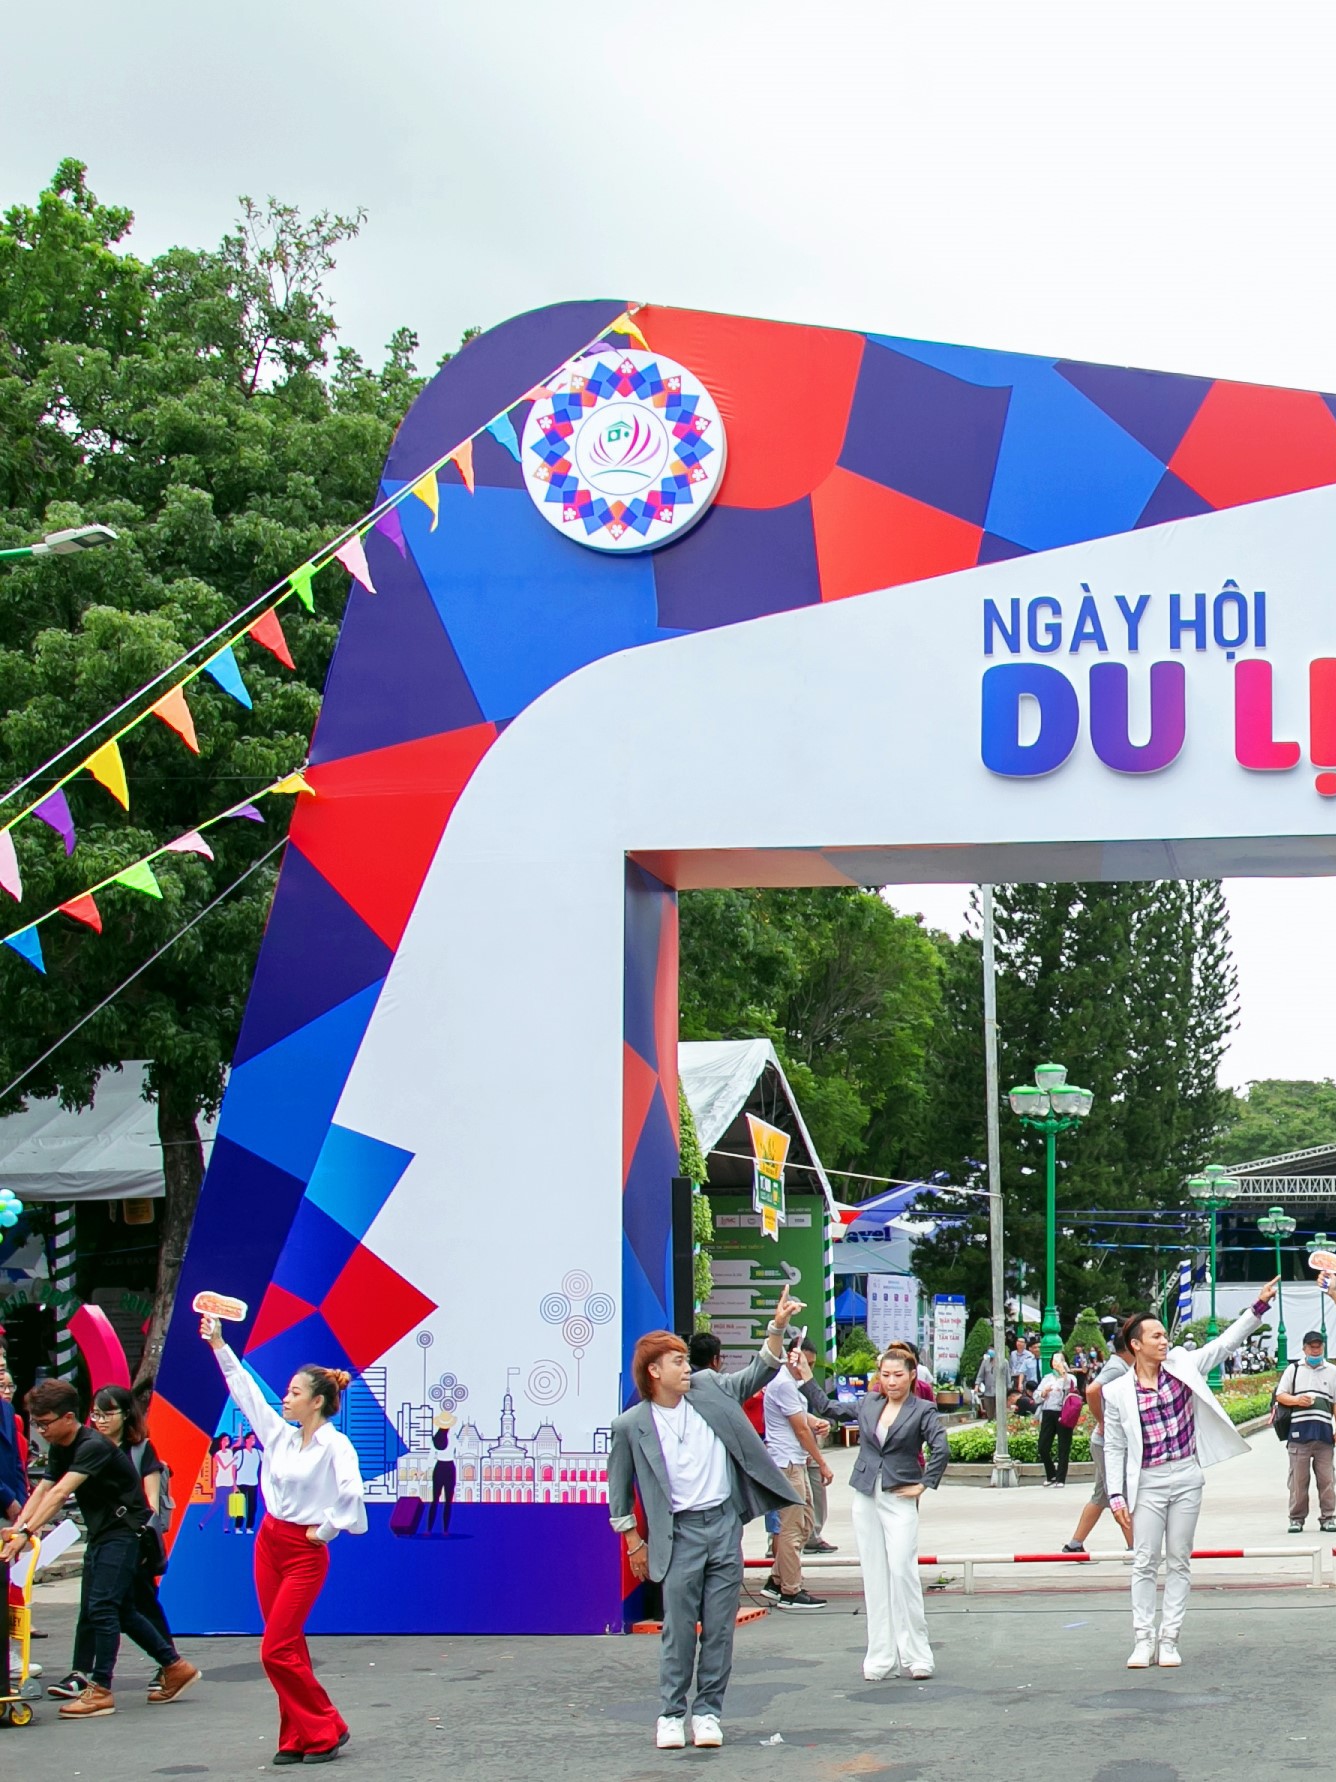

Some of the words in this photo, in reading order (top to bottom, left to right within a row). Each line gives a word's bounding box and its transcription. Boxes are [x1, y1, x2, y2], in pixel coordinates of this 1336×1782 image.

[983, 582, 1152, 656] NGÀY
[1169, 578, 1267, 662] HỘI
[981, 660, 1186, 778] DU
[834, 1226, 892, 1244] avel
